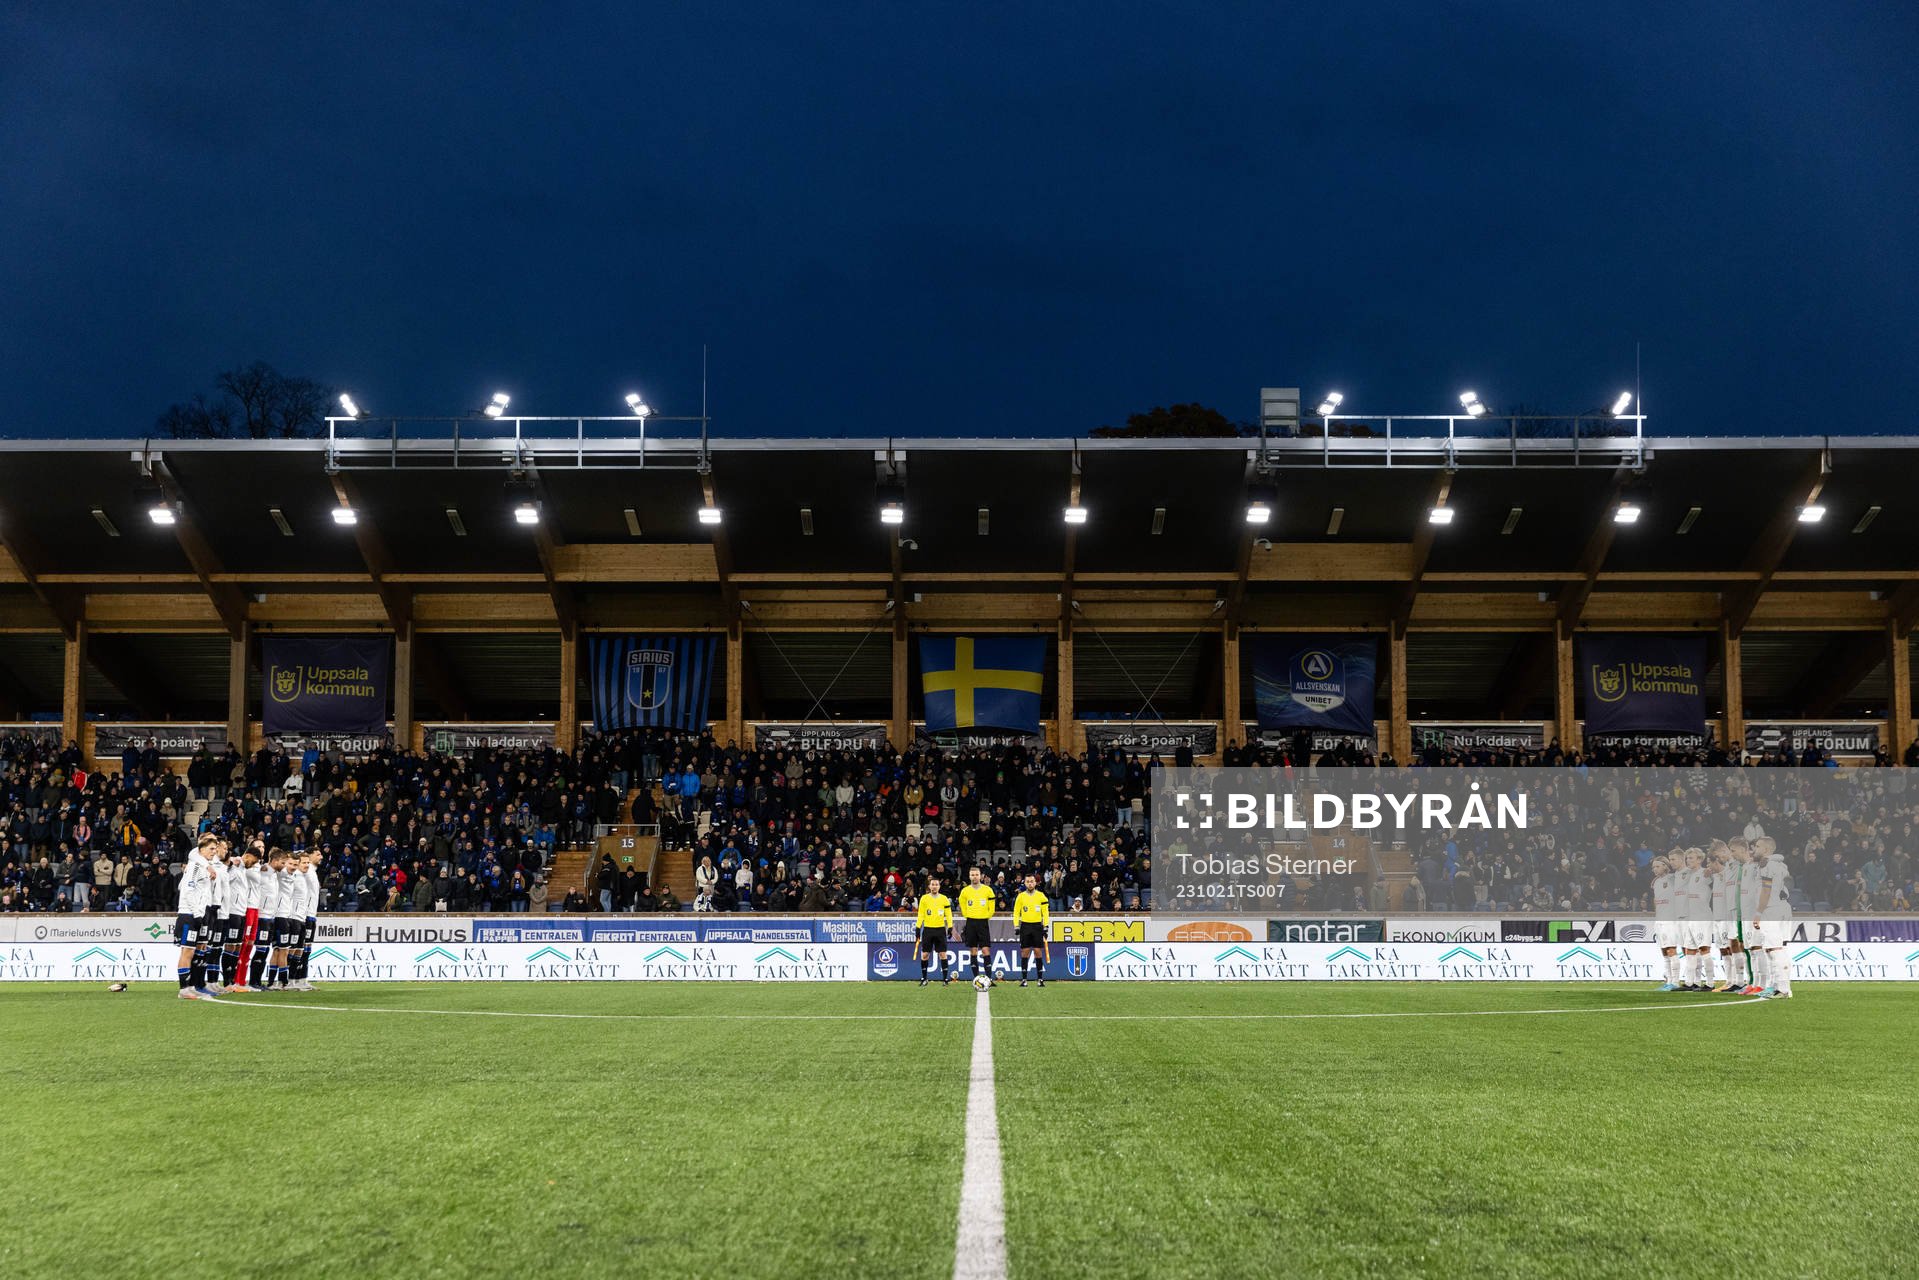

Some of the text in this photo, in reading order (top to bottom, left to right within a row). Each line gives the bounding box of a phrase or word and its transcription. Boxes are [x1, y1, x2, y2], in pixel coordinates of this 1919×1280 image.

[631, 652, 670, 664] SIRIUS
[307, 665, 368, 682] Uppsala
[1631, 662, 1691, 679] Uppsala
[306, 680, 375, 697] kommun
[1295, 682, 1340, 693] ALLSVENSKAN
[1632, 677, 1698, 695] kommun
[1305, 696, 1332, 704] UNIBET
[487, 735, 529, 747] laddar
[969, 736, 987, 746] Nu
[1140, 734, 1148, 746] 3
[1454, 735, 1473, 746] Nu
[1519, 735, 1532, 746] vi
[1656, 735, 1702, 747] match!
[1792, 737, 1869, 750] BIFORUM
[621, 838, 634, 848] 15
[1333, 838, 1345, 848] 14
[318, 925, 353, 937] Måleri
[822, 921, 867, 933] Maskin&
[1285, 920, 1367, 942] notar
[525, 932, 579, 940] CENTRALEN
[595, 932, 634, 942] SKROT
[640, 933, 693, 942] CENTRALEN
[708, 931, 751, 941] UPPSALA
[755, 930, 810, 940] HANDELSSTÅL
[1393, 929, 1496, 942] EKONOMIKUM
[11, 948, 35, 961] KA
[122, 948, 146, 961] KA
[352, 948, 376, 961] KA
[463, 948, 488, 961] KA
[575, 948, 599, 961] KA
[692, 948, 717, 961] KA
[804, 948, 828, 961] KA
[1152, 948, 1176, 961] KA
[1263, 948, 1288, 961] KA
[1375, 948, 1400, 961] KA
[1487, 948, 1512, 961] KA
[1606, 948, 1631, 961] KA
[1841, 948, 1867, 961] KA
[72, 962, 167, 978] TAKTVÄTT
[309, 962, 397, 978] AKTVÄTT
[413, 962, 509, 978] TAKTVÄTT
[525, 962, 620, 978] TAKTVÄTT
[642, 962, 738, 978] TAKTVÄTT
[754, 962, 849, 978] TAKTVÄTT
[1102, 962, 1198, 978] TAKTVÄTT
[1214, 962, 1310, 978] TAKTVÄTT
[1325, 962, 1422, 978] TAKTVÄTT
[1438, 962, 1534, 978] TAKTVÄTT
[1556, 962, 1654, 978] TAKTVÄTT
[1792, 962, 1889, 978] TAKTVÄTT
